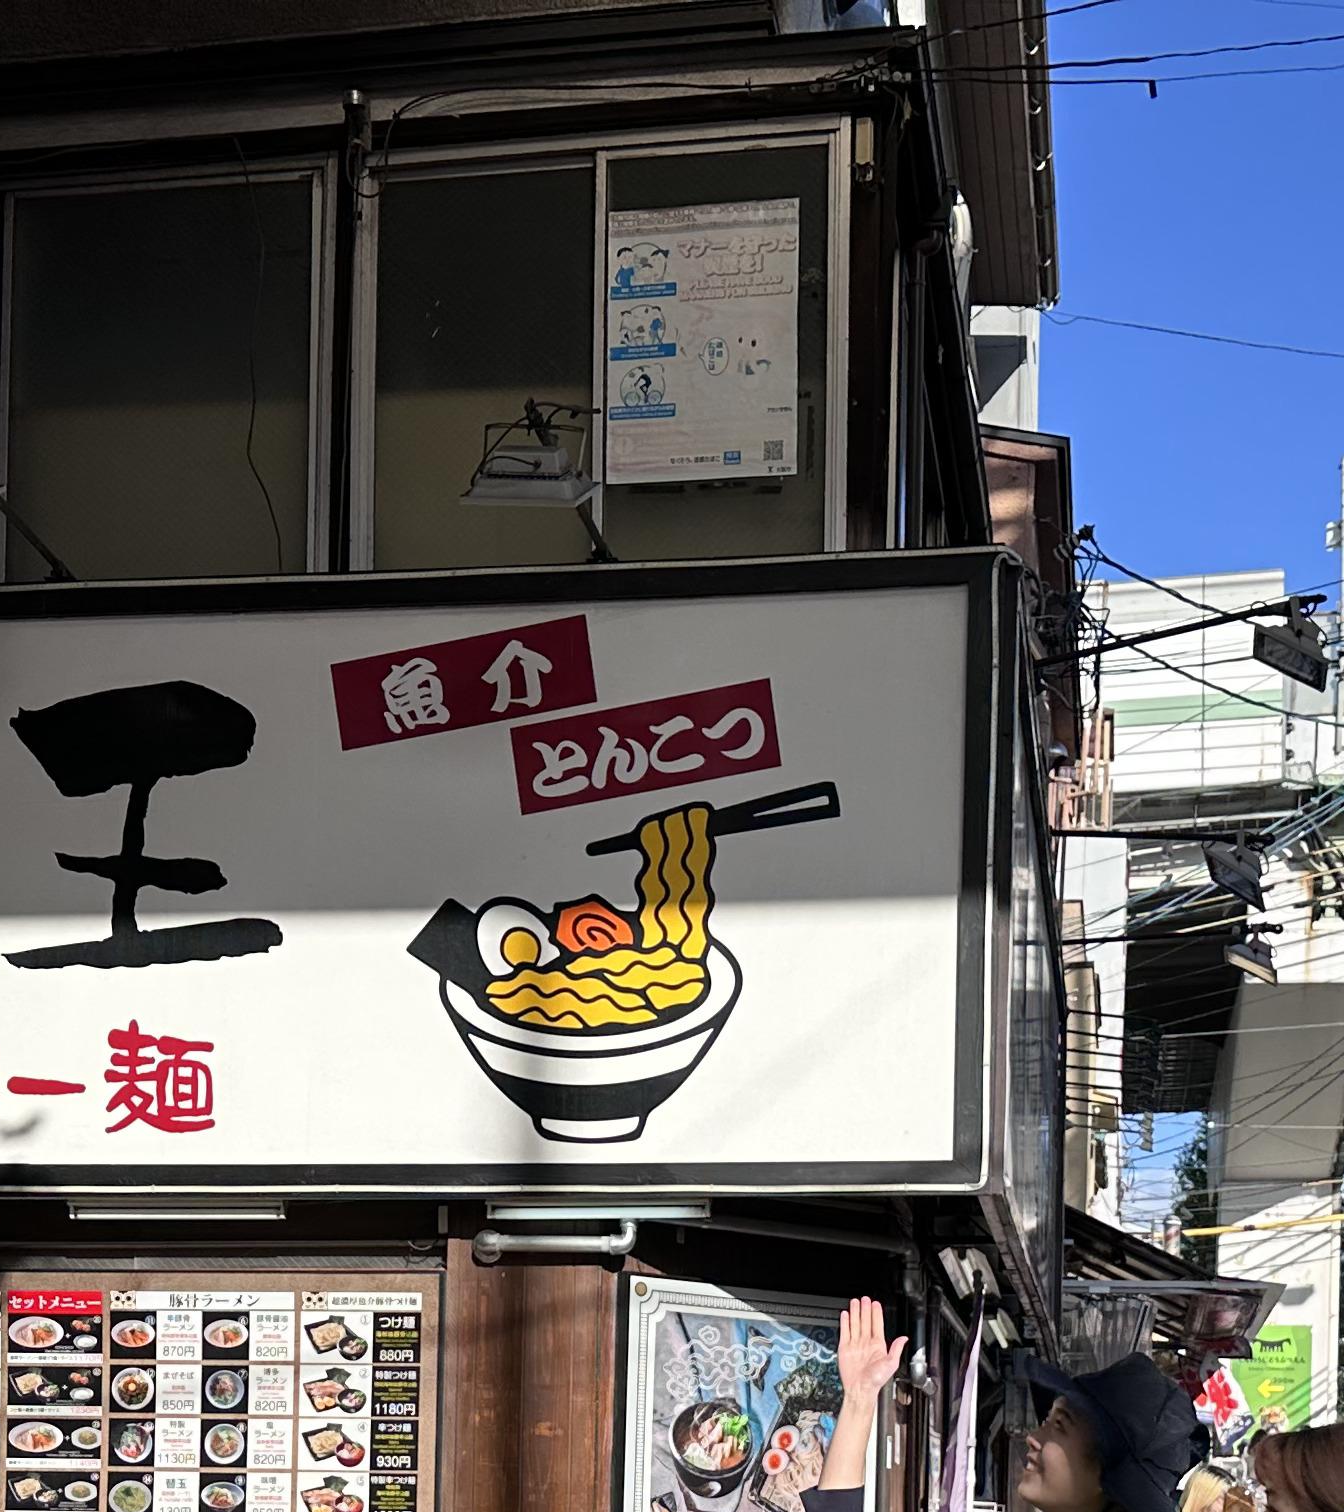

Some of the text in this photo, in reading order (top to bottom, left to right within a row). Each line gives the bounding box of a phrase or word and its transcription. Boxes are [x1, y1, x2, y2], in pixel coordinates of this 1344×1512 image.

[383, 639, 553, 733] 魚介
[532, 707, 765, 798] とんこつ
[9, 1295, 101, 1309] セットメニュー
[379, 1316, 415, 1328] つけ麺
[163, 1346, 195, 1357] 870円
[256, 1346, 288, 1358] 820円
[379, 1350, 414, 1361] 880円
[162, 1400, 194, 1411] 850円
[255, 1401, 287, 1412] 820円
[375, 1403, 415, 1415] 1180円
[158, 1453, 196, 1464] 1130円
[253, 1454, 286, 1465] 820円
[376, 1456, 411, 1468] 930円
